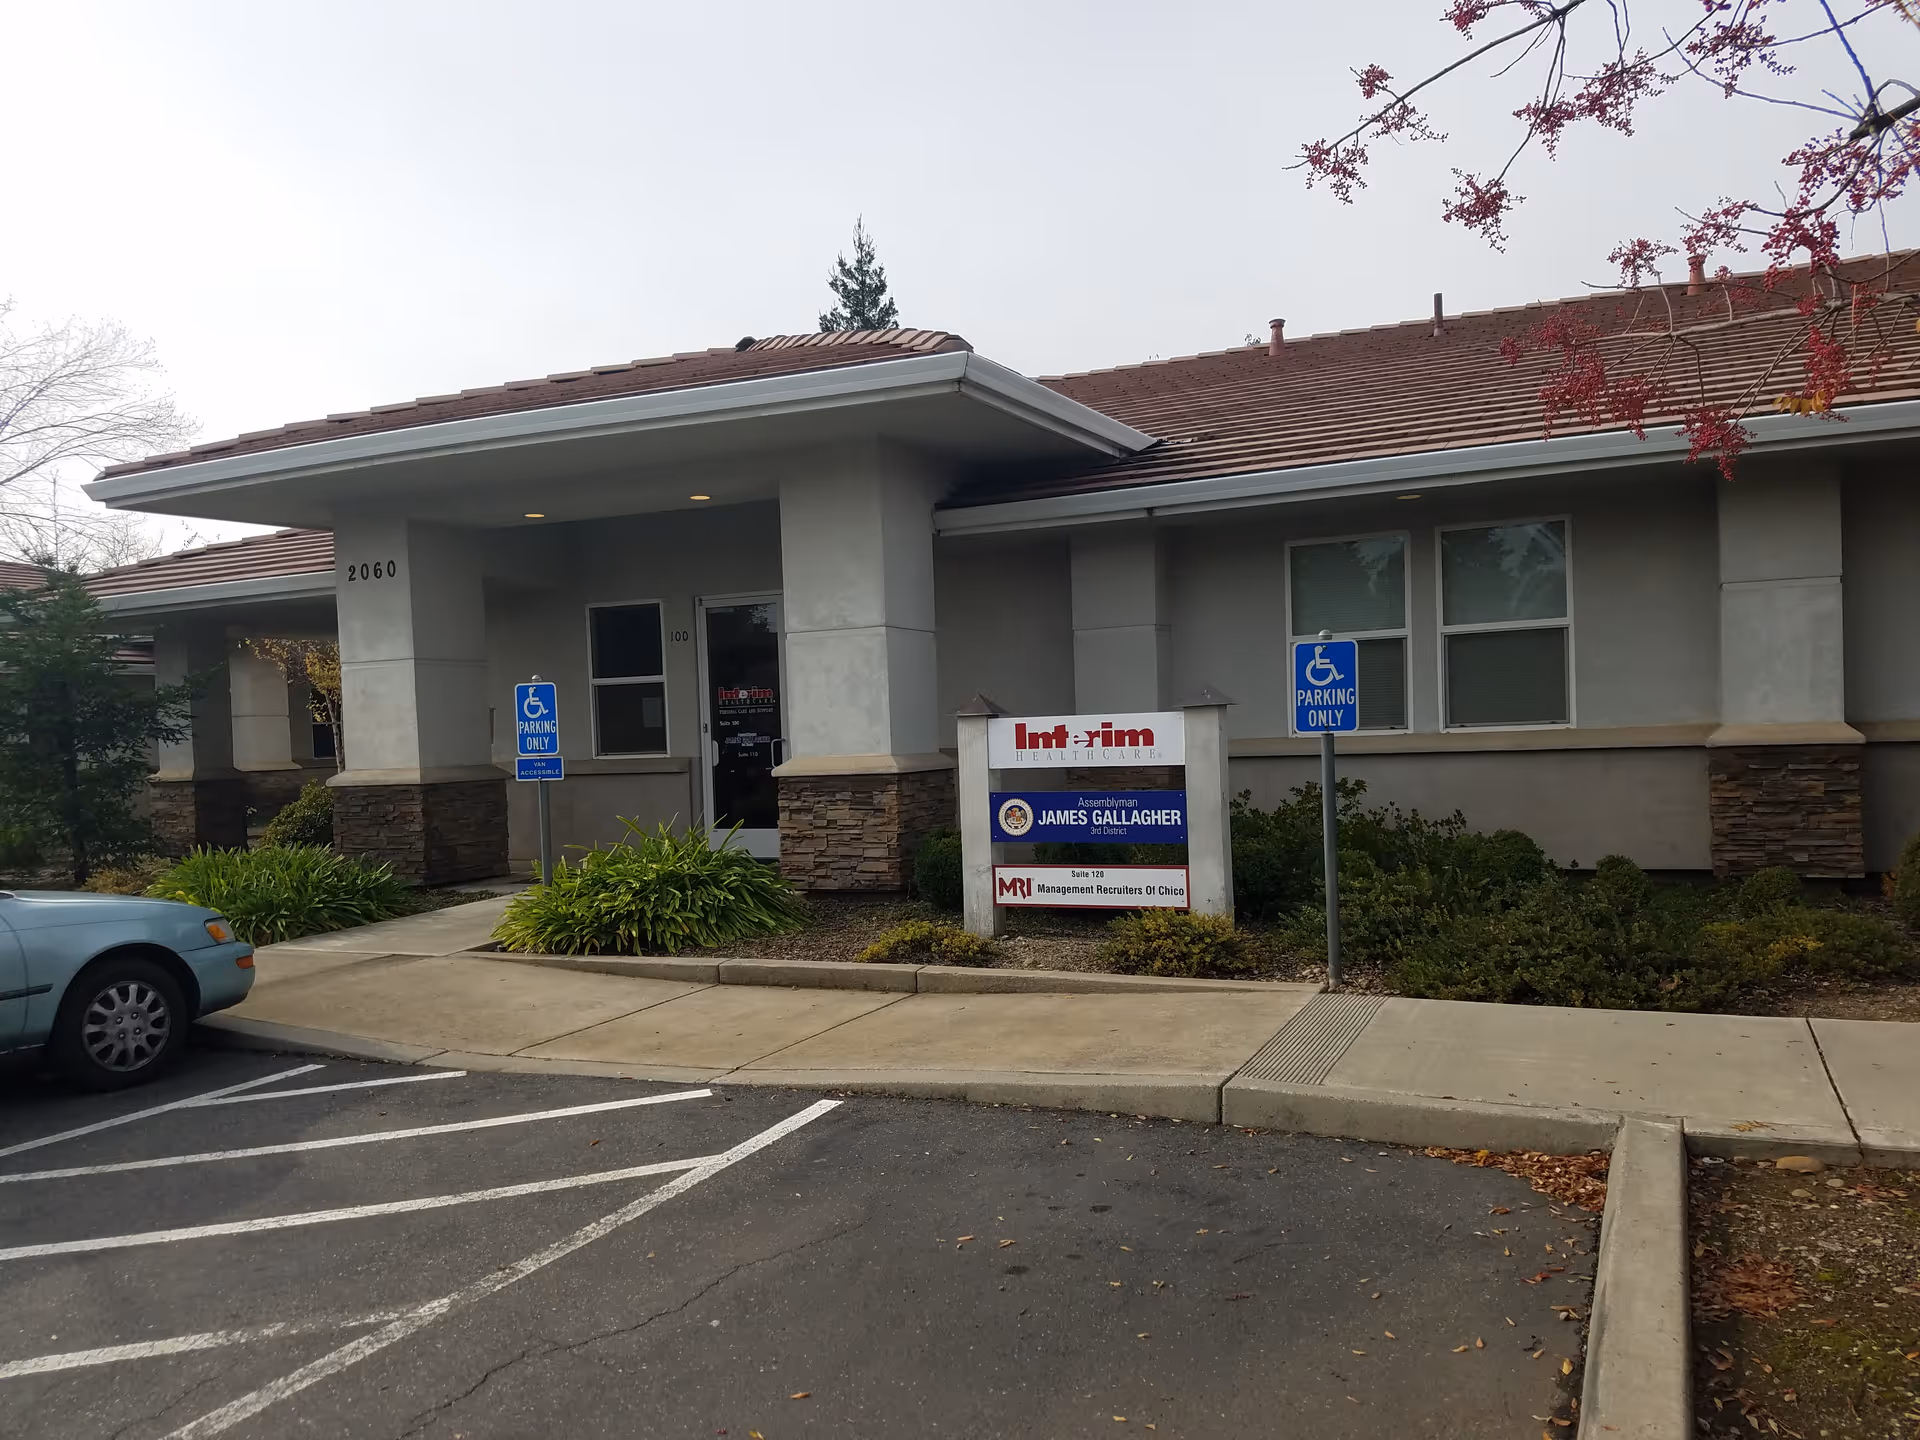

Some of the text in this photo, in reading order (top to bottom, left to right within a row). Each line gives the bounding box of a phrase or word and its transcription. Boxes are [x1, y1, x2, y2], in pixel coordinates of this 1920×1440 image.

[349, 560, 396, 582] 2060
[670, 630, 689, 642] 100
[718, 686, 773, 700] Interim
[1297, 688, 1355, 707] PARKING
[1308, 709, 1344, 727] ONLY
[519, 720, 556, 735] PARKING
[1014, 721, 1155, 750] Interim
[526, 736, 550, 751] ONLY
[1016, 748, 1156, 762] HEALTHCARE
[1078, 797, 1138, 809] Assemblyman
[1038, 810, 1088, 826] JAMES
[1092, 809, 1182, 826] GALLAGHER
[1090, 826, 1127, 835] 3rd District
[1071, 870, 1105, 878] Suite 120
[998, 877, 1032, 900] MRI
[1037, 883, 1185, 896] Management Recruiters Of Chico
